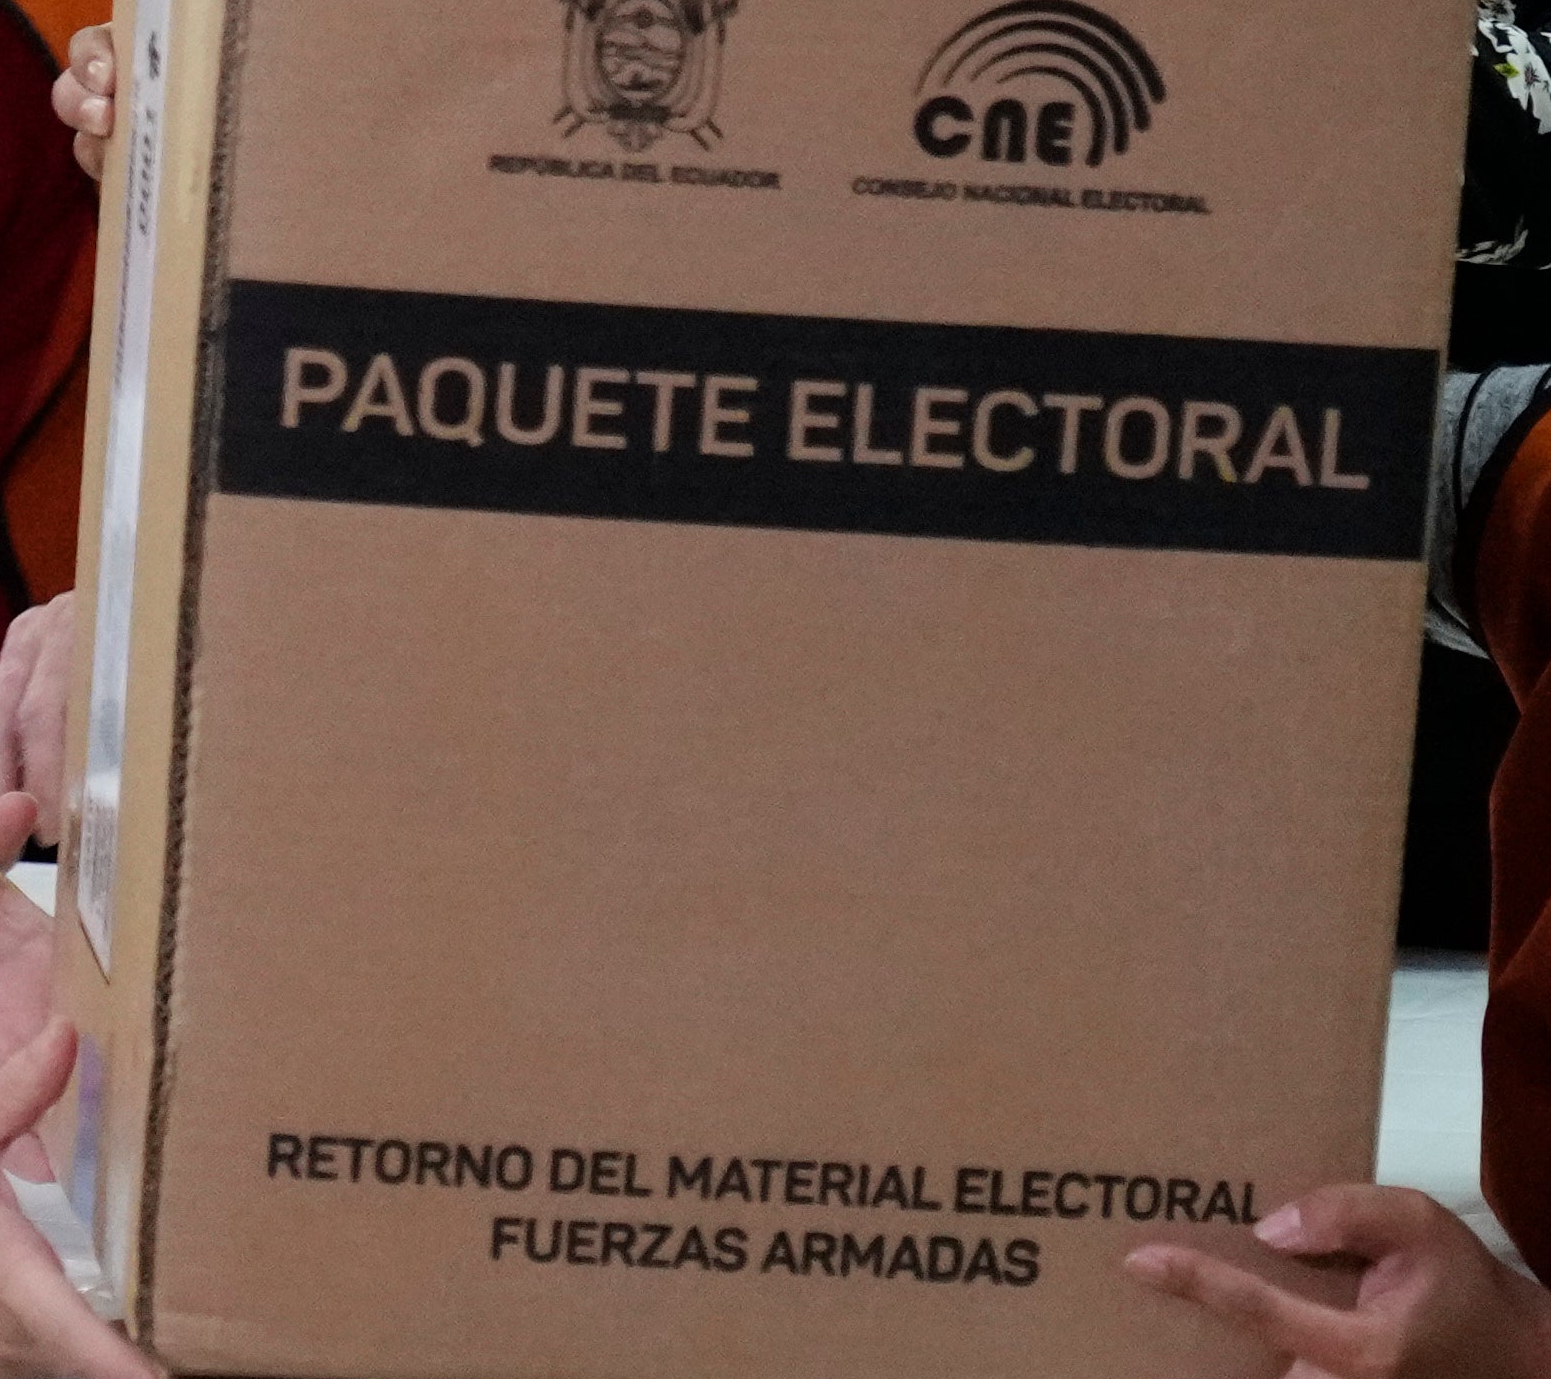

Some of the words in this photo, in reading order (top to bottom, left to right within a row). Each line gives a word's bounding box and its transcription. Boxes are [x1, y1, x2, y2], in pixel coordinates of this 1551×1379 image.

[914, 96, 1076, 166] CNE
[671, 166, 781, 190] ECUADOR
[852, 176, 957, 200] CONSEJO
[963, 184, 1075, 208] NACIONAL
[1081, 189, 1211, 215] ELECTORAL
[280, 347, 759, 458] PAQUETE
[786, 379, 1371, 491] ELECTORAL
[266, 1134, 532, 1192] RETORNO
[550, 1151, 651, 1198] DEL
[666, 1159, 940, 1214] MATERIAL
[953, 1171, 1260, 1227] ELECTORAL
[489, 1219, 747, 1272] FUERZAS
[761, 1232, 1041, 1286] ARMADAS
